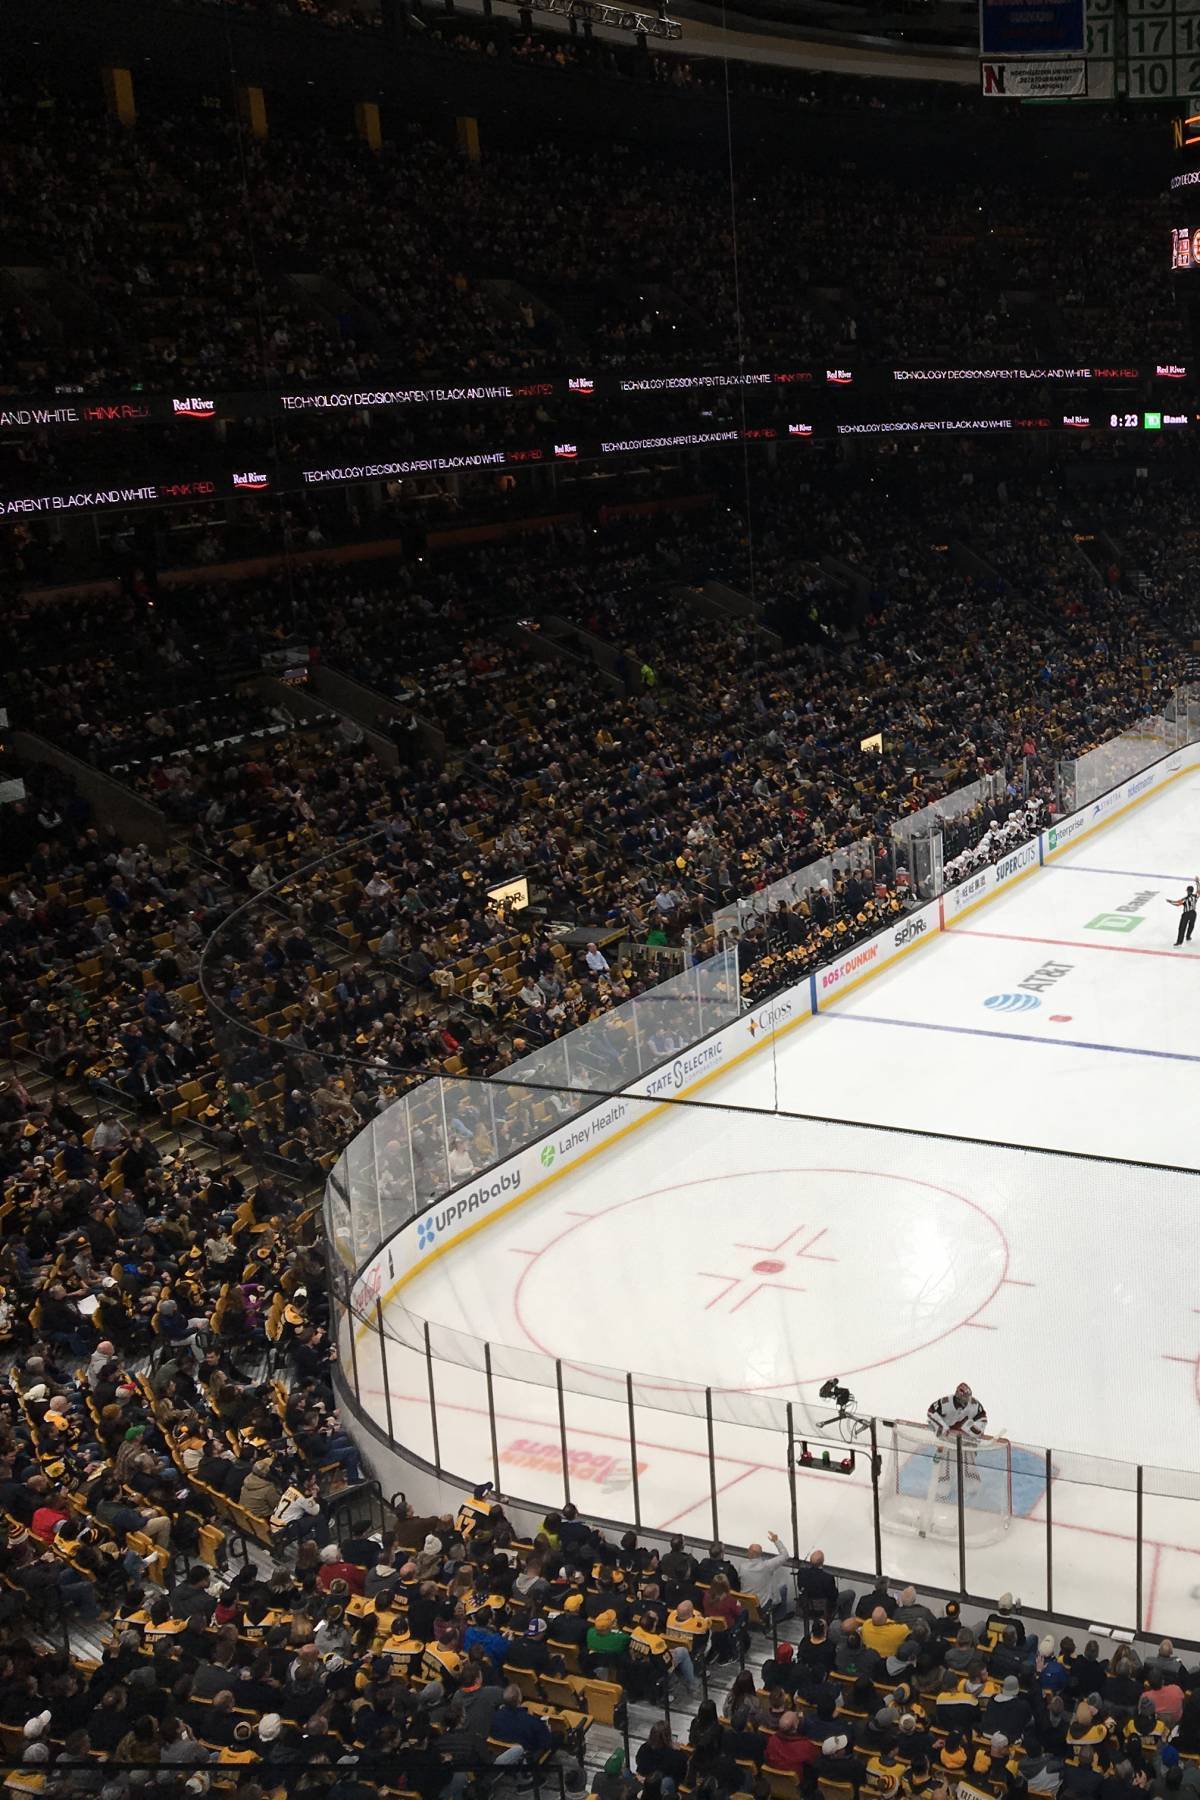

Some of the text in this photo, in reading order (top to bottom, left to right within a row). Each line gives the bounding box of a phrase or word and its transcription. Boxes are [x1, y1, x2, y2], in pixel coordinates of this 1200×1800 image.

[1132, 21, 1167, 53] 17
[1131, 63, 1168, 94] 10
[1019, 368, 1047, 379] BLACK
[1048, 368, 1064, 378] AND
[1156, 365, 1186, 375] Red River
[172, 398, 214, 411] Red River
[281, 386, 486, 410] TECHNOLOGY DECISIONS BLACK AND
[0, 411, 32, 426] AND
[947, 419, 972, 430] BLACK
[972, 419, 990, 429] AND
[1063, 415, 1089, 425] Red River
[1109, 413, 1139, 428] 8:23
[1163, 414, 1188, 425] Bank
[232, 471, 267, 485] Red River
[302, 455, 465, 484] TECHNOLOGY BLACK
[52, 490, 121, 510] BLACK AND
[996, 847, 1037, 883] SUPERCUTS
[1115, 889, 1161, 913] Bank
[822, 971, 840, 988] BOS
[1017, 960, 1075, 993] AT&T
[647, 1041, 722, 1097] STATE ELECTRIC
[558, 1105, 626, 1155] Lahey Health
[434, 1169, 522, 1232] UPPAbaby
